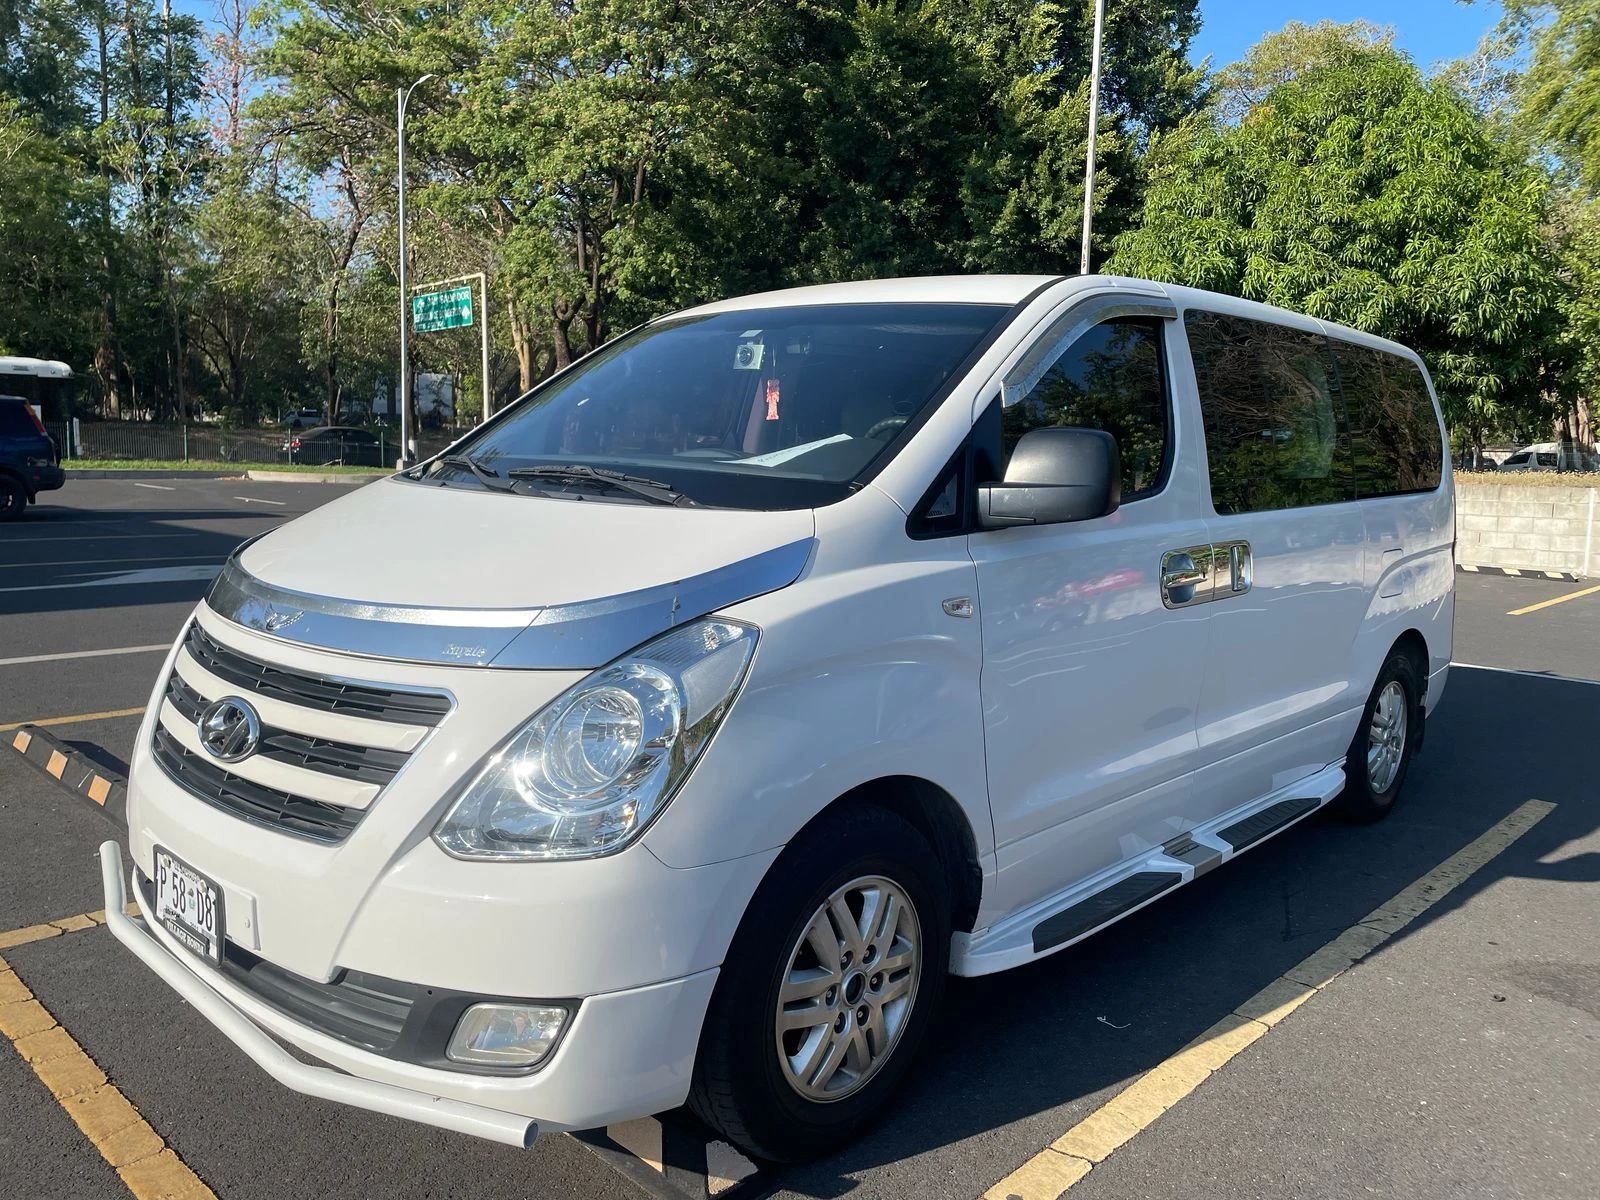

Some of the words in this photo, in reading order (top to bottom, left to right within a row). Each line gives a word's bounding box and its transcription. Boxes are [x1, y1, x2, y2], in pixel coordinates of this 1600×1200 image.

[160, 865, 167, 898] P
[172, 872, 186, 914] 58
[196, 887, 213, 932] D8
